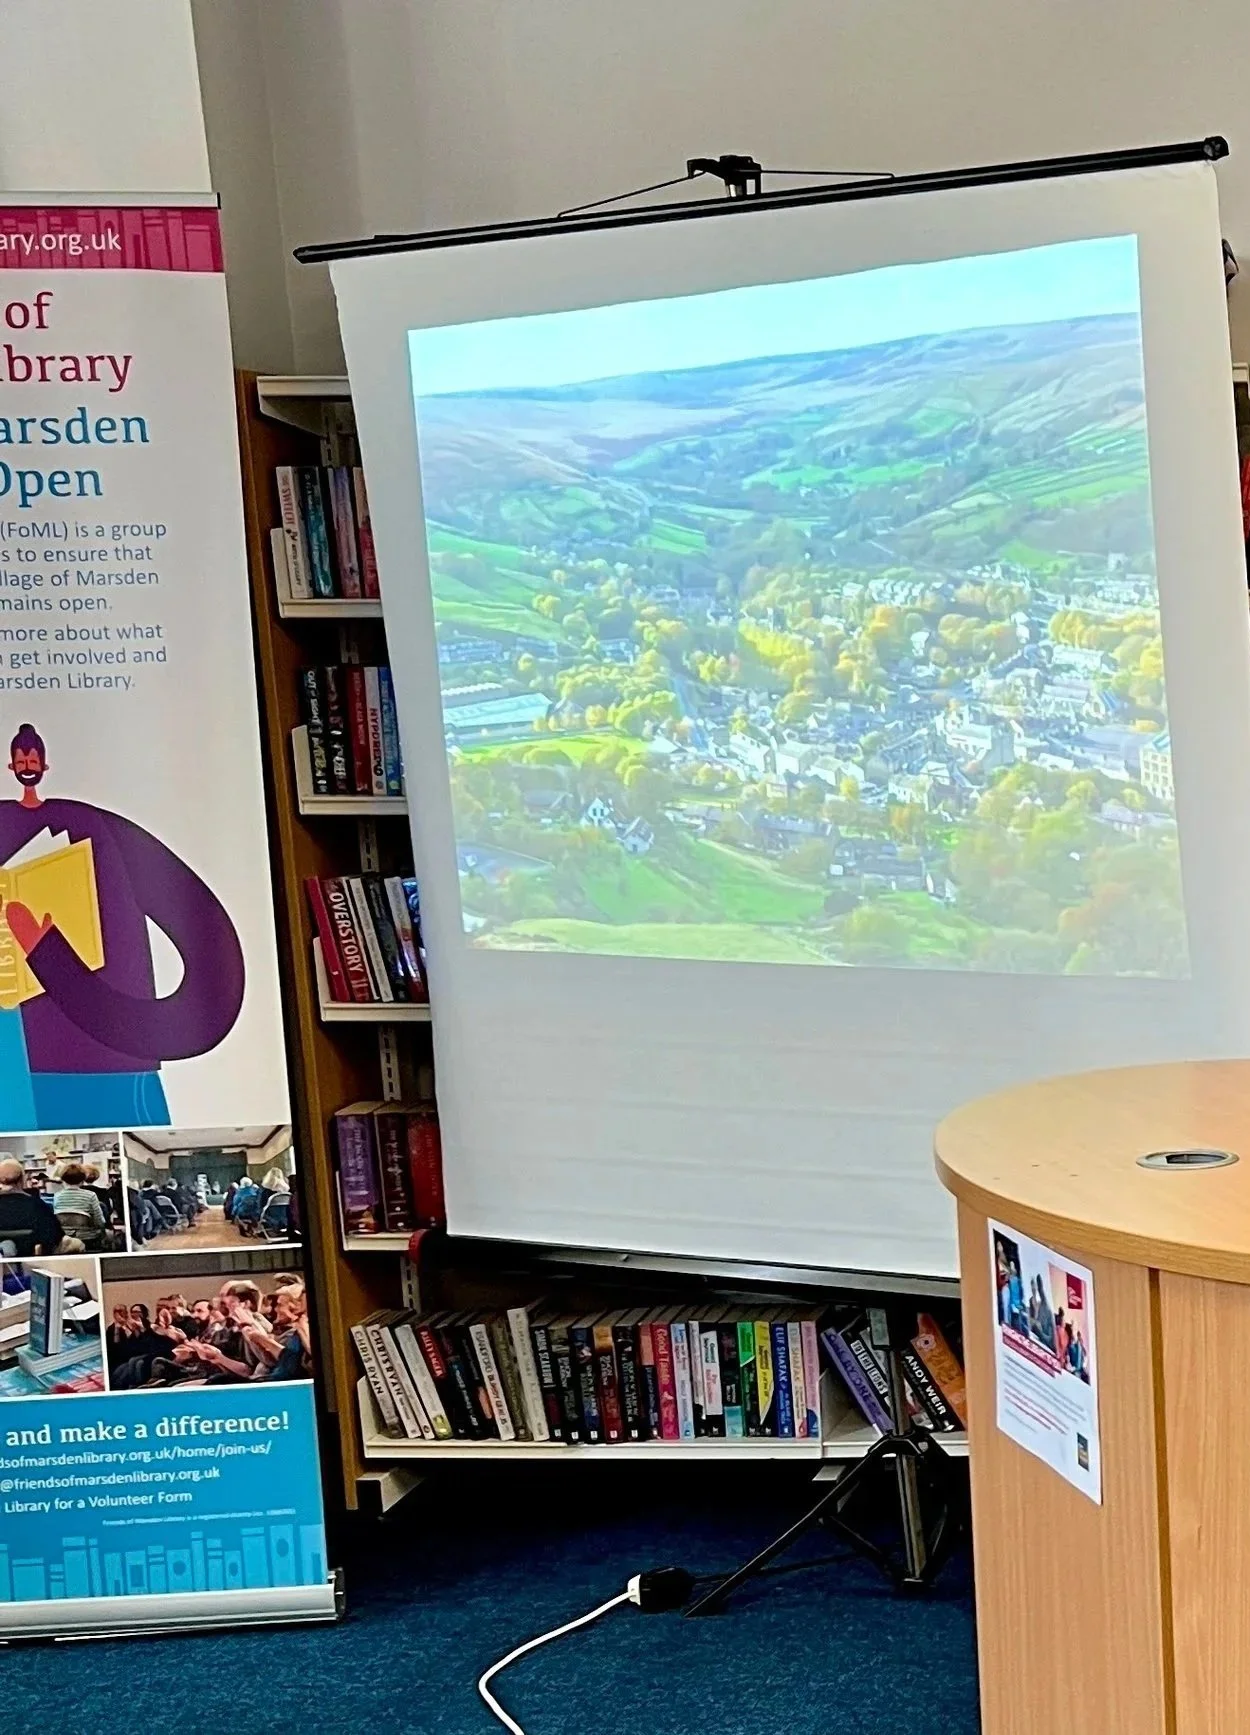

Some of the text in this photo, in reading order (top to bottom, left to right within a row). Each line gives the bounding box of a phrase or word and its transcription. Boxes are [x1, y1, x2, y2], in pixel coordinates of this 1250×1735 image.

[5, 291, 53, 329] of
[0, 344, 132, 392] brary
[1, 521, 167, 541] (FoML) is a group
[17, 548, 36, 562] to
[44, 548, 108, 562] ensure
[114, 546, 152, 560] that
[51, 569, 69, 587] of
[77, 569, 159, 586] Marsden
[59, 597, 113, 614] open.
[55, 624, 111, 641] about
[117, 623, 163, 640] what
[10, 650, 41, 669] get
[47, 648, 126, 665] involved
[133, 646, 167, 663] and
[68, 672, 136, 690] Library.
[308, 671, 317, 689] OUT
[329, 893, 363, 972] OVERSTORY
[655, 1328, 667, 1354] Good
[775, 1327, 787, 1382] ELIF SHAFAK
[355, 1330, 384, 1395] CHRIS RYAN
[371, 1329, 404, 1395] CHRIS RYAN
[658, 1355, 671, 1384] Taste
[858, 1354, 872, 1370] THE
[868, 1369, 888, 1394] LIONS
[905, 1354, 928, 1384] ANDY
[925, 1385, 947, 1415] WEIR
[6, 1411, 289, 1446] and make a difference!
[0, 1466, 220, 1493] @friendsofmarsdenlibrary.org.uk
[5, 1491, 193, 1513] Library for a Volunteer Form
